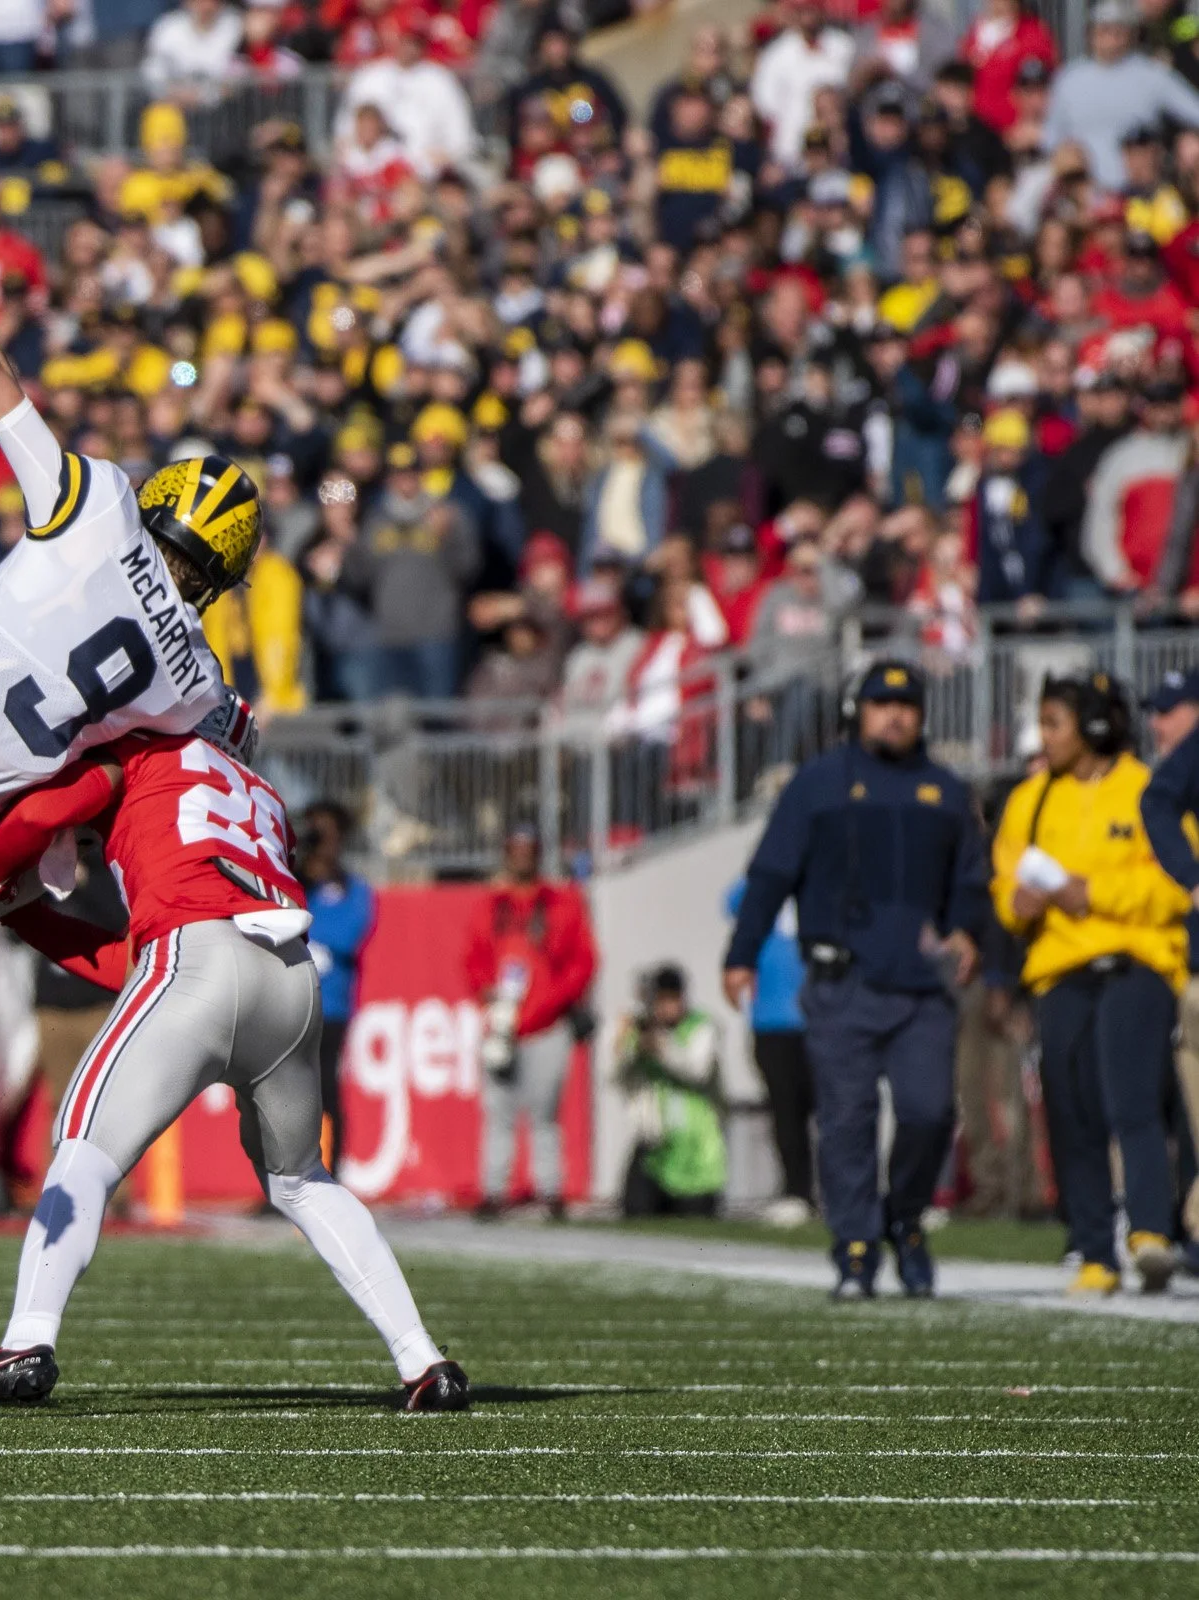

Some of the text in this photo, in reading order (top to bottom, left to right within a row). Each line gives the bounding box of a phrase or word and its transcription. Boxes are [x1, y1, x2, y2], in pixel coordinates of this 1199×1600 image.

[4, 616, 158, 758] 9
[120, 543, 207, 697] McCARTHY
[338, 997, 480, 1198] ger
